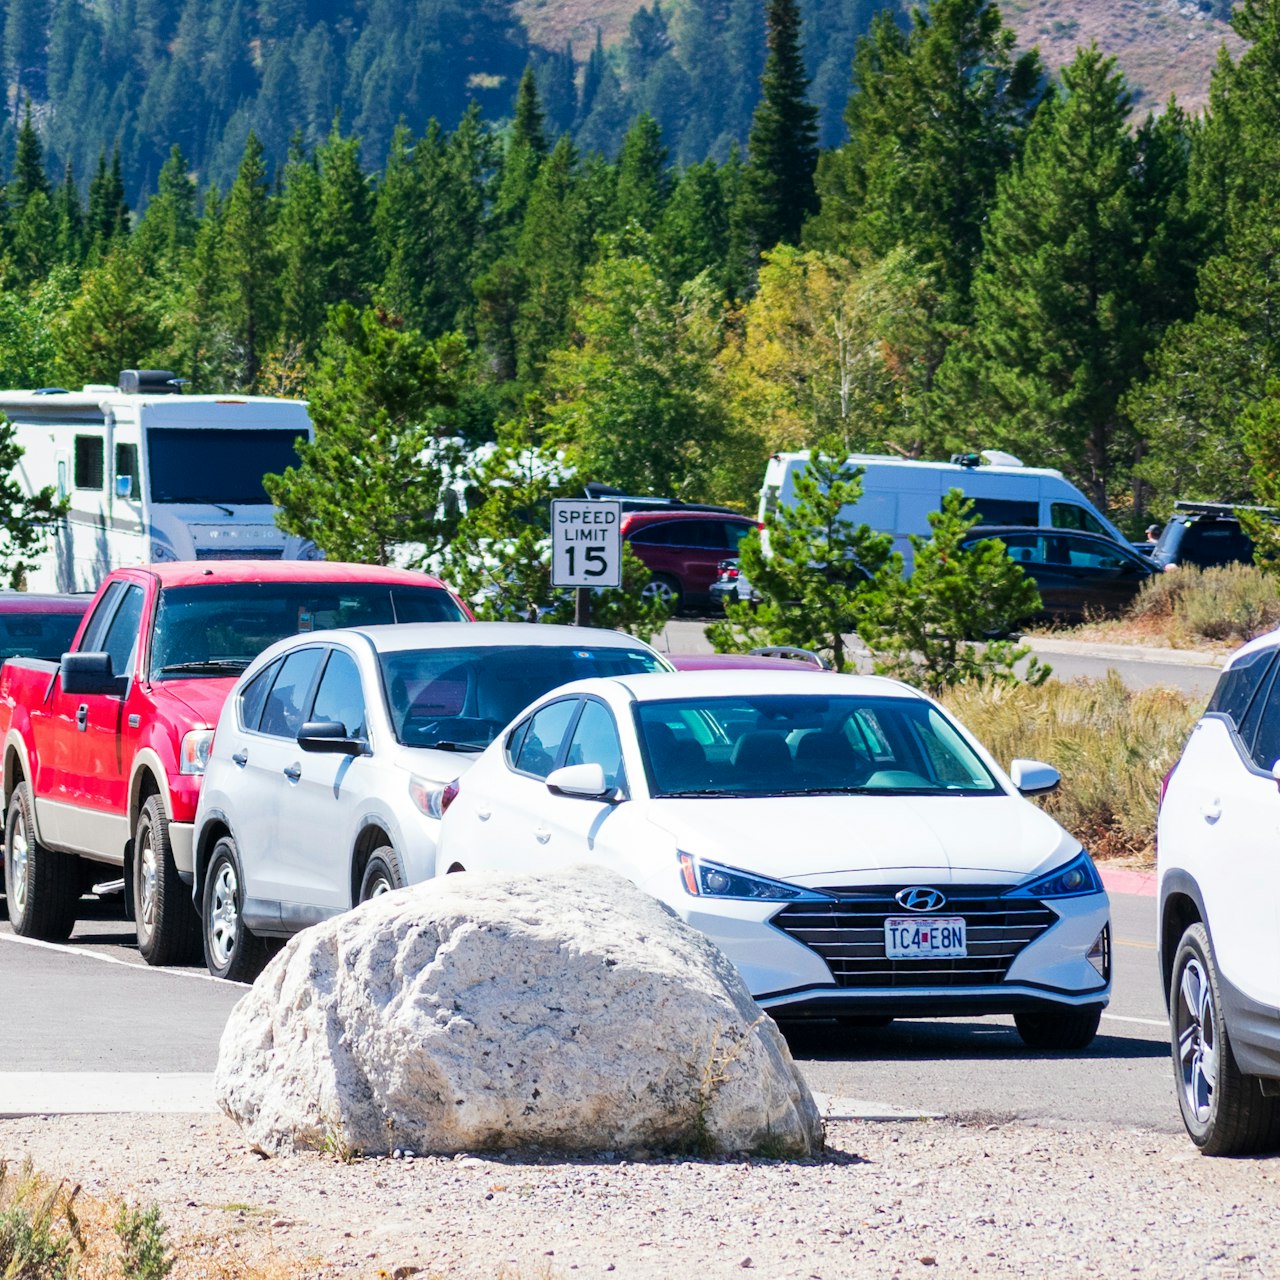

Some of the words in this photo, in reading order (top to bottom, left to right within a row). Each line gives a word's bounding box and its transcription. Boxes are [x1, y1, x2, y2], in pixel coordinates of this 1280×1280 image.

[558, 510, 616, 524] SPEED
[564, 529, 608, 541] LIMIT
[565, 546, 608, 576] 15
